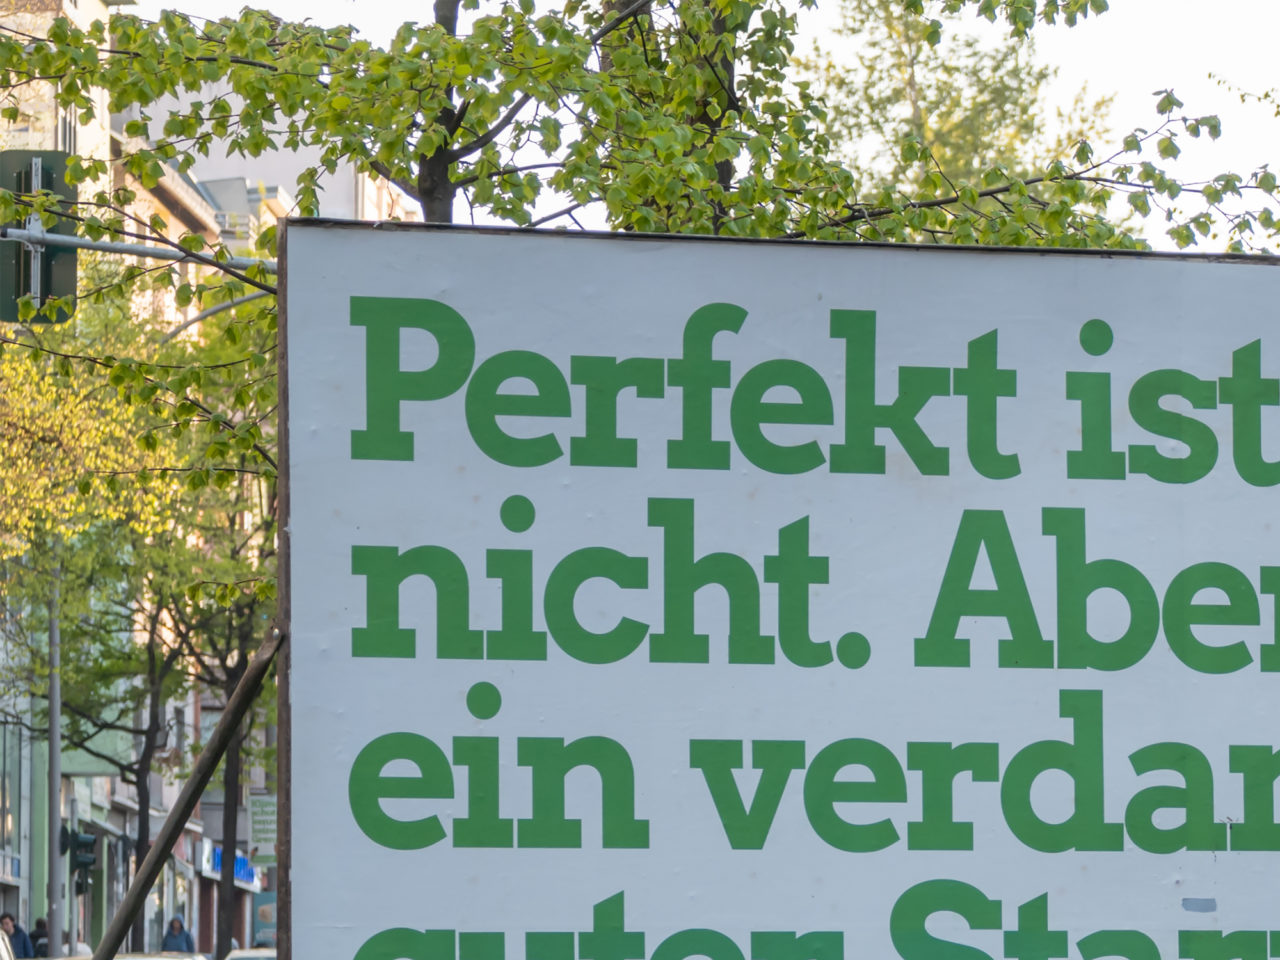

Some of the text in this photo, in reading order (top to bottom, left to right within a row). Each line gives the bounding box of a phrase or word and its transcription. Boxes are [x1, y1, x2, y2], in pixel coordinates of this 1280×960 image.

[350, 297, 1019, 478] Perfekt
[352, 496, 871, 669] nicht.
[350, 683, 648, 849] ein
